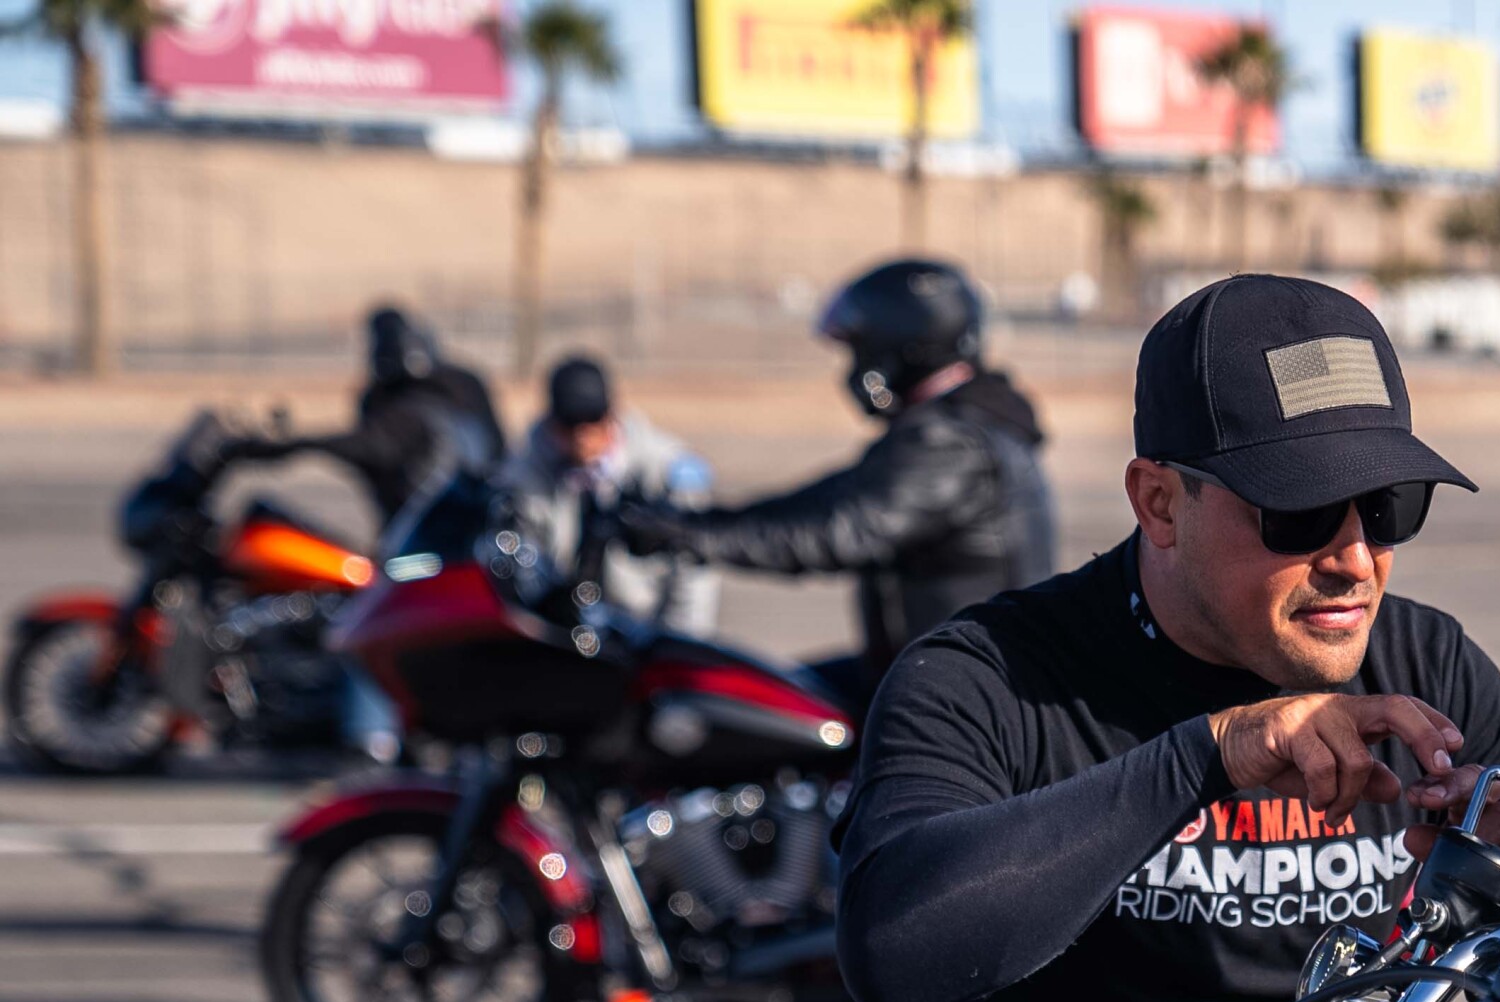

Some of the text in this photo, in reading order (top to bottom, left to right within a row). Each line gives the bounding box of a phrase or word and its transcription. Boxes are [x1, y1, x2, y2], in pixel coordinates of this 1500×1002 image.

[1126, 827, 1415, 895] HAMPIONS
[1116, 883, 1393, 928] RIDING SCHOOL
